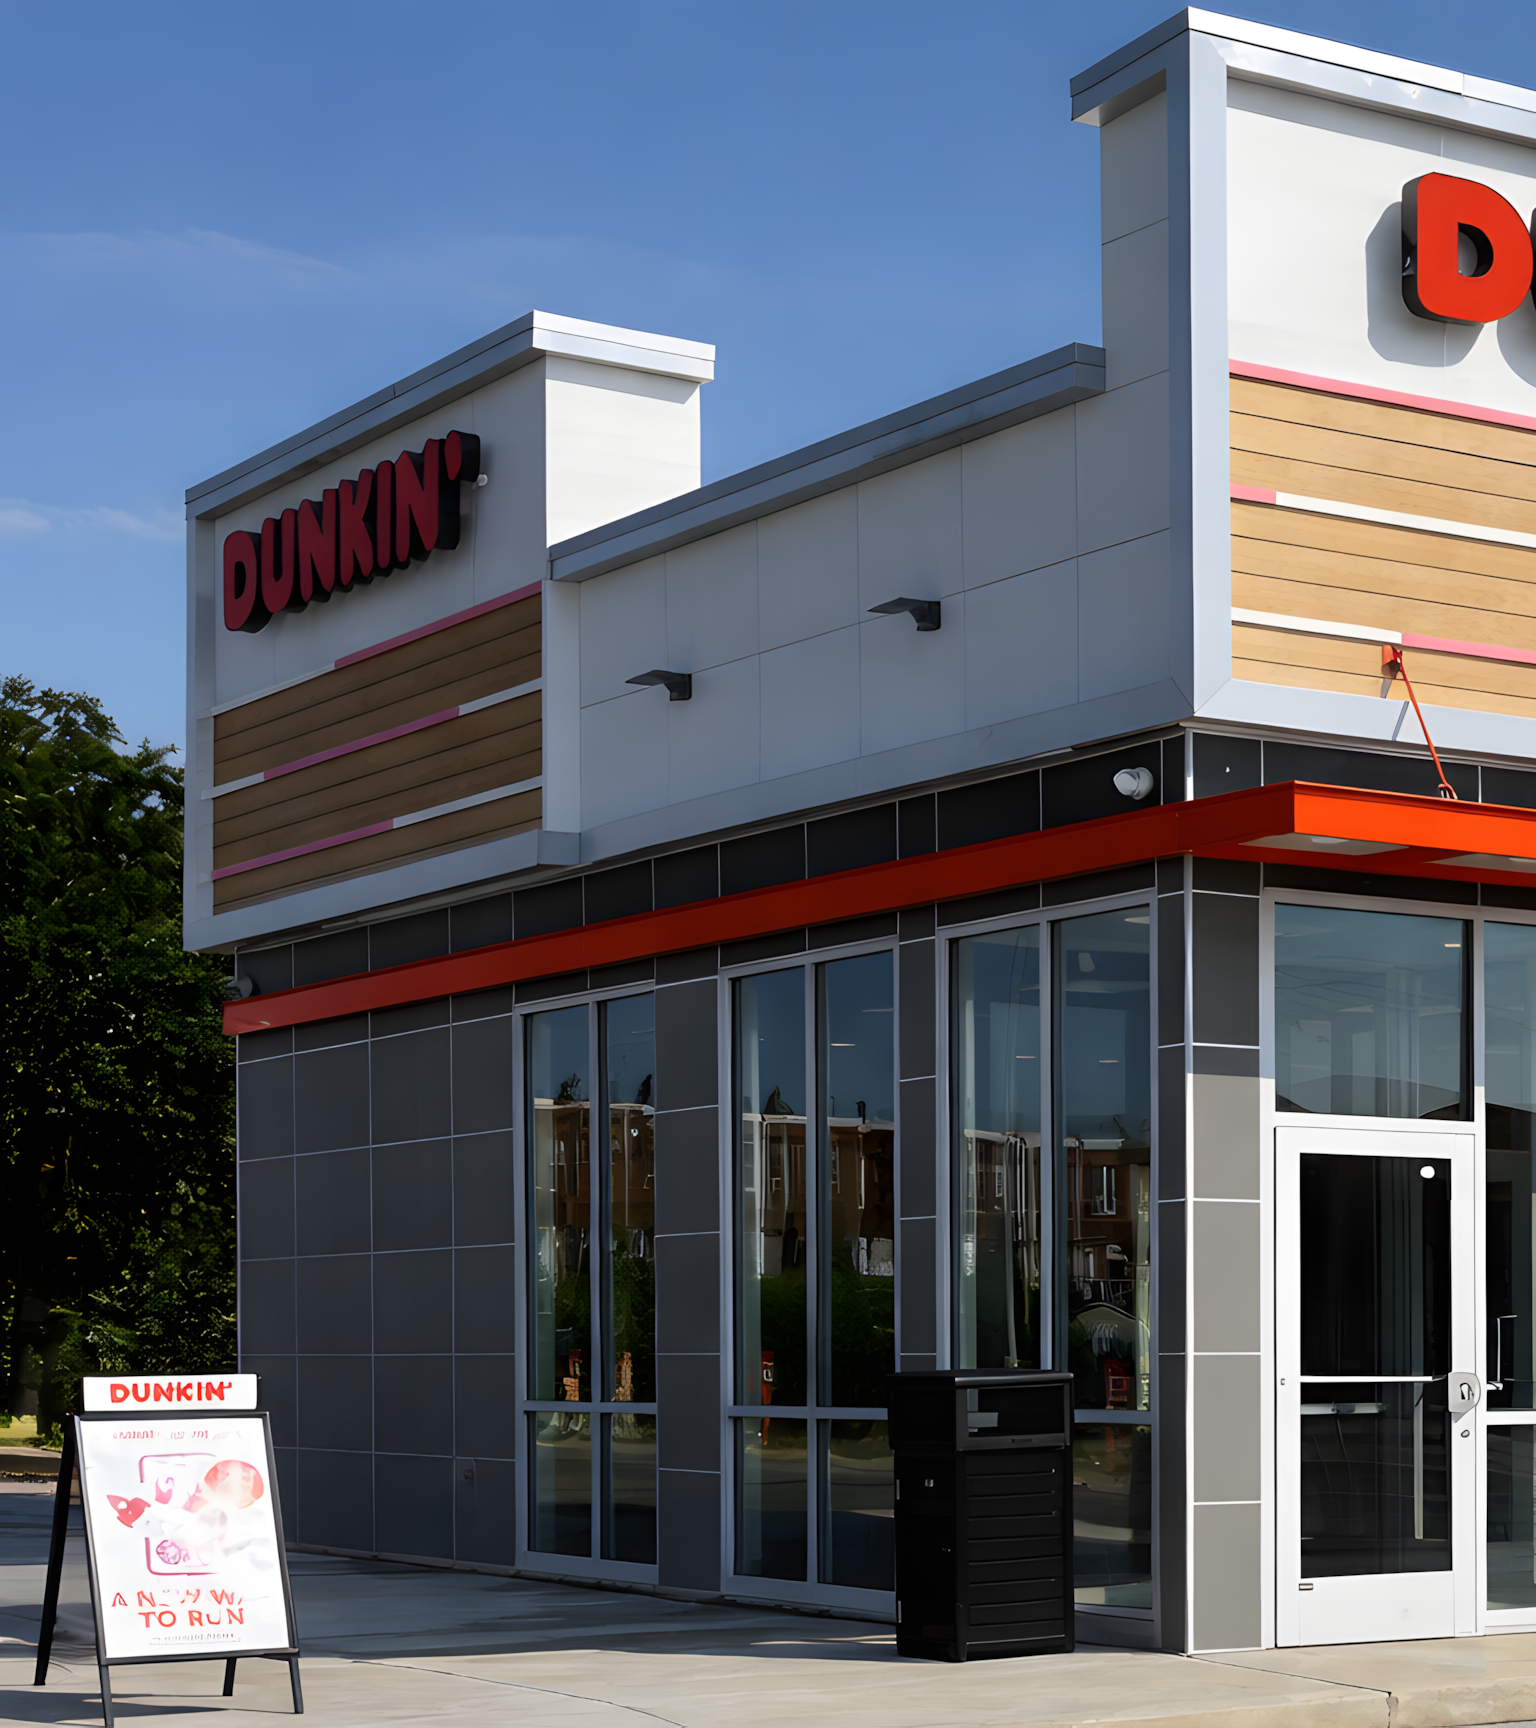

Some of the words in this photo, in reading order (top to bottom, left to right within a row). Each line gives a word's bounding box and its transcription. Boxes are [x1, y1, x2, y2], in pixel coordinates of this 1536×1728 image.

[223, 430, 478, 633] DUNKIN'
[110, 1381, 232, 1403] DUNKIN'
[138, 1610, 176, 1628] TO
[188, 1608, 243, 1626] RUN
